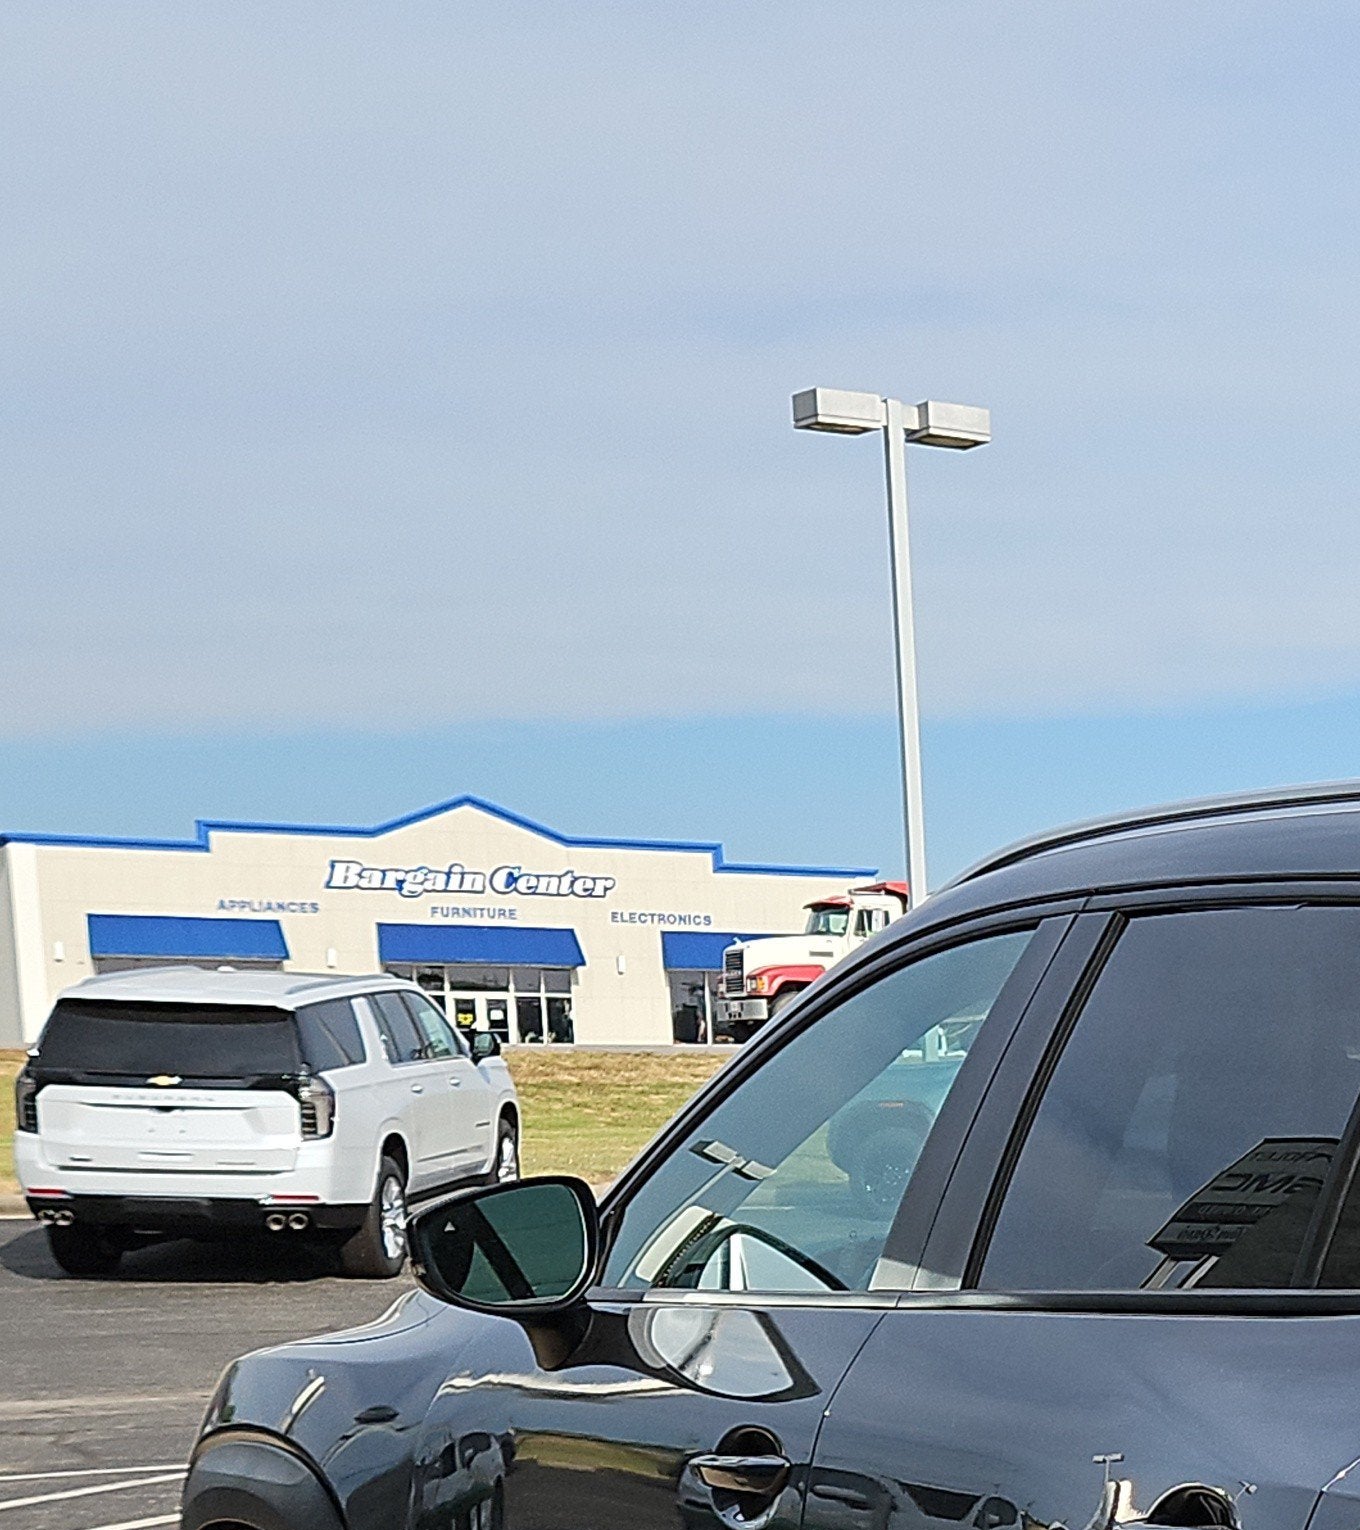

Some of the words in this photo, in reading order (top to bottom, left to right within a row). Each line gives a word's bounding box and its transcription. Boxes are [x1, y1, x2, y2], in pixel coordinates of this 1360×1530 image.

[325, 859, 485, 898] Bargain
[490, 865, 616, 898] Center
[217, 900, 320, 914] APPLIANCES
[430, 906, 518, 920] FURNITURE
[610, 911, 712, 926] ELECTRONICS
